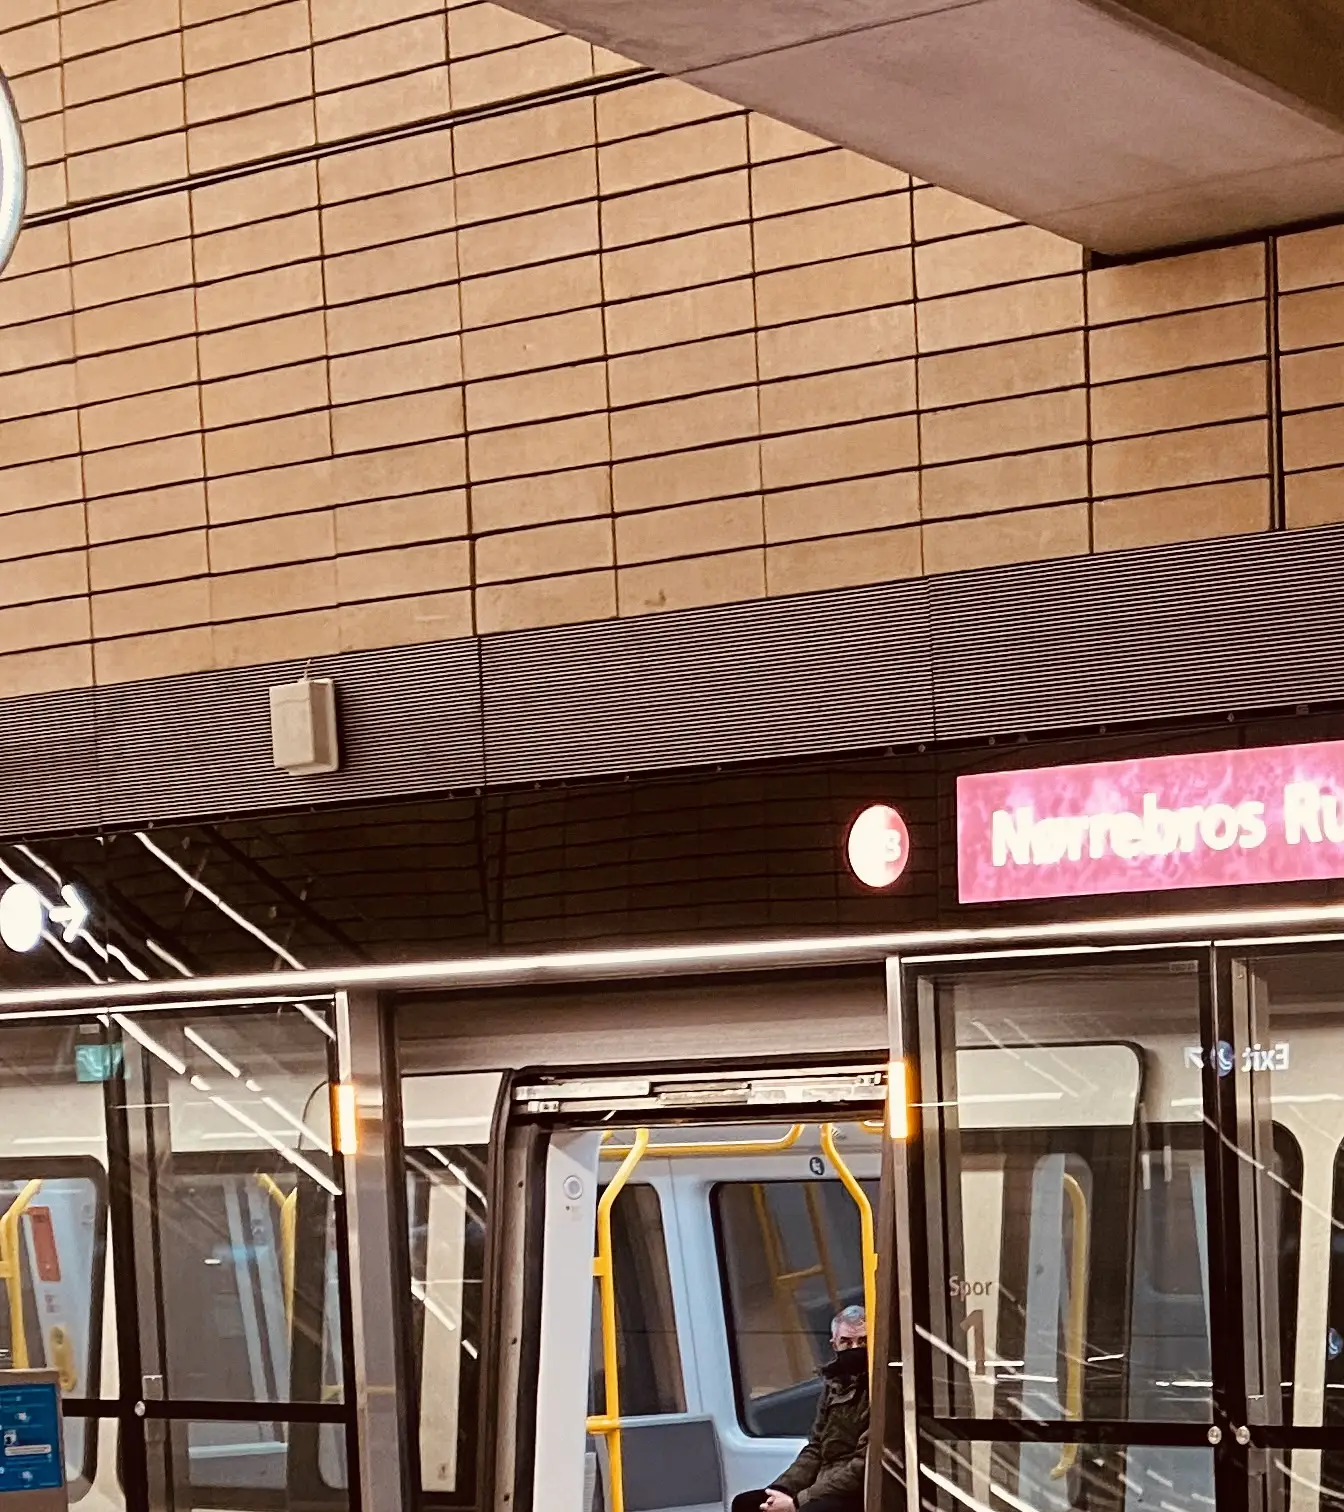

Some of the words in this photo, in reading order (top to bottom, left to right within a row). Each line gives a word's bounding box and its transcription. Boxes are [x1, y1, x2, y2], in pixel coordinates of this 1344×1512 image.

[992, 792, 1266, 867] Nørrebros
[949, 1275, 992, 1302] Spor
[960, 1309, 985, 1376] 1
